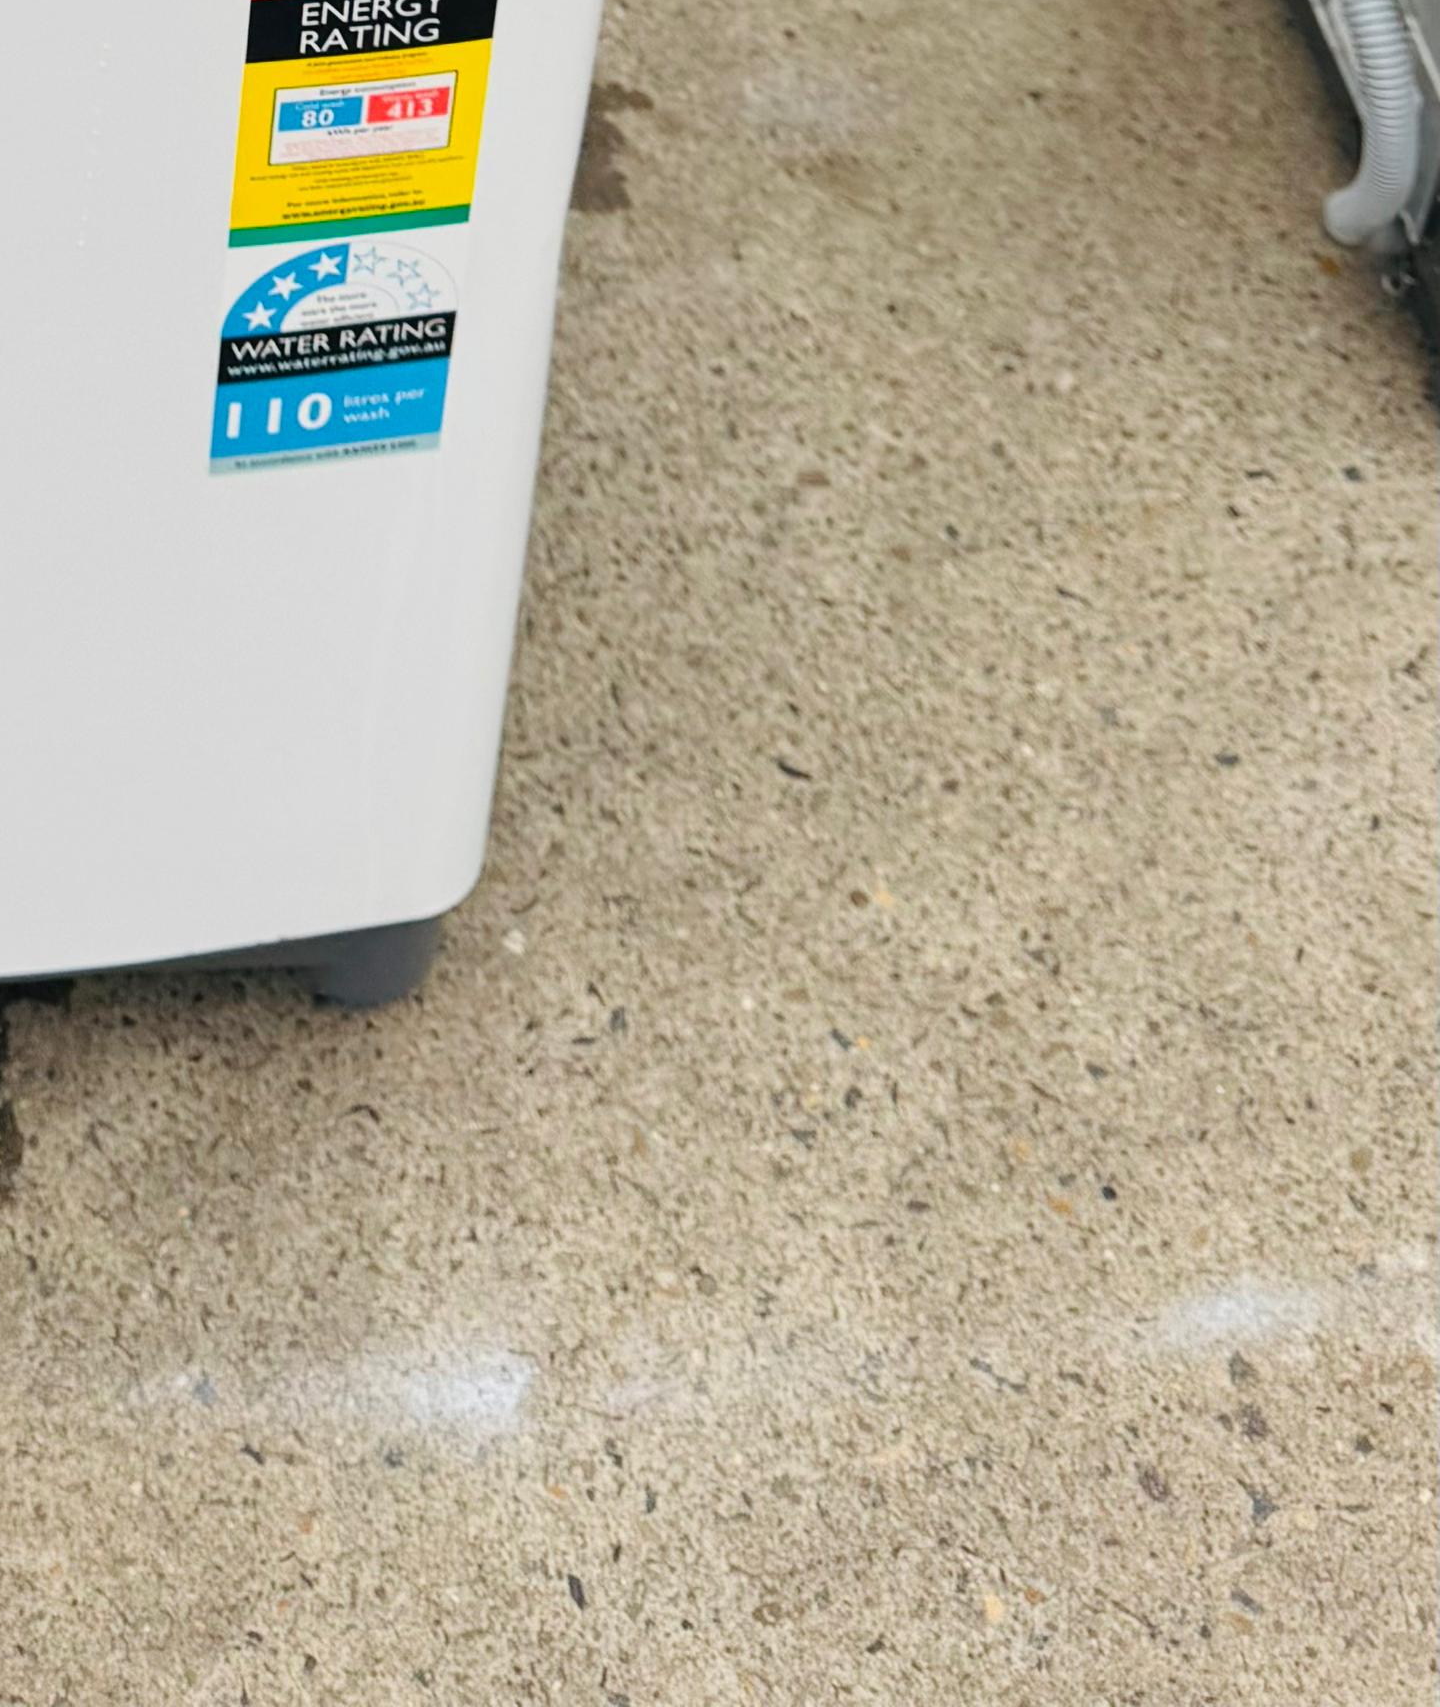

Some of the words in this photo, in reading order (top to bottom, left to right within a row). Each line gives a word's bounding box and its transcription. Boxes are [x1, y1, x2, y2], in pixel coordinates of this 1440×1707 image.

[299, 18, 441, 54] RATING
[301, 109, 334, 128] 80
[387, 98, 433, 118] 413
[231, 333, 330, 361] WATER
[339, 318, 447, 349] RATING
[227, 339, 446, 377] www.waterrating.gov.au
[226, 392, 332, 438] 110
[394, 387, 425, 405] per
[343, 406, 390, 424] wash
